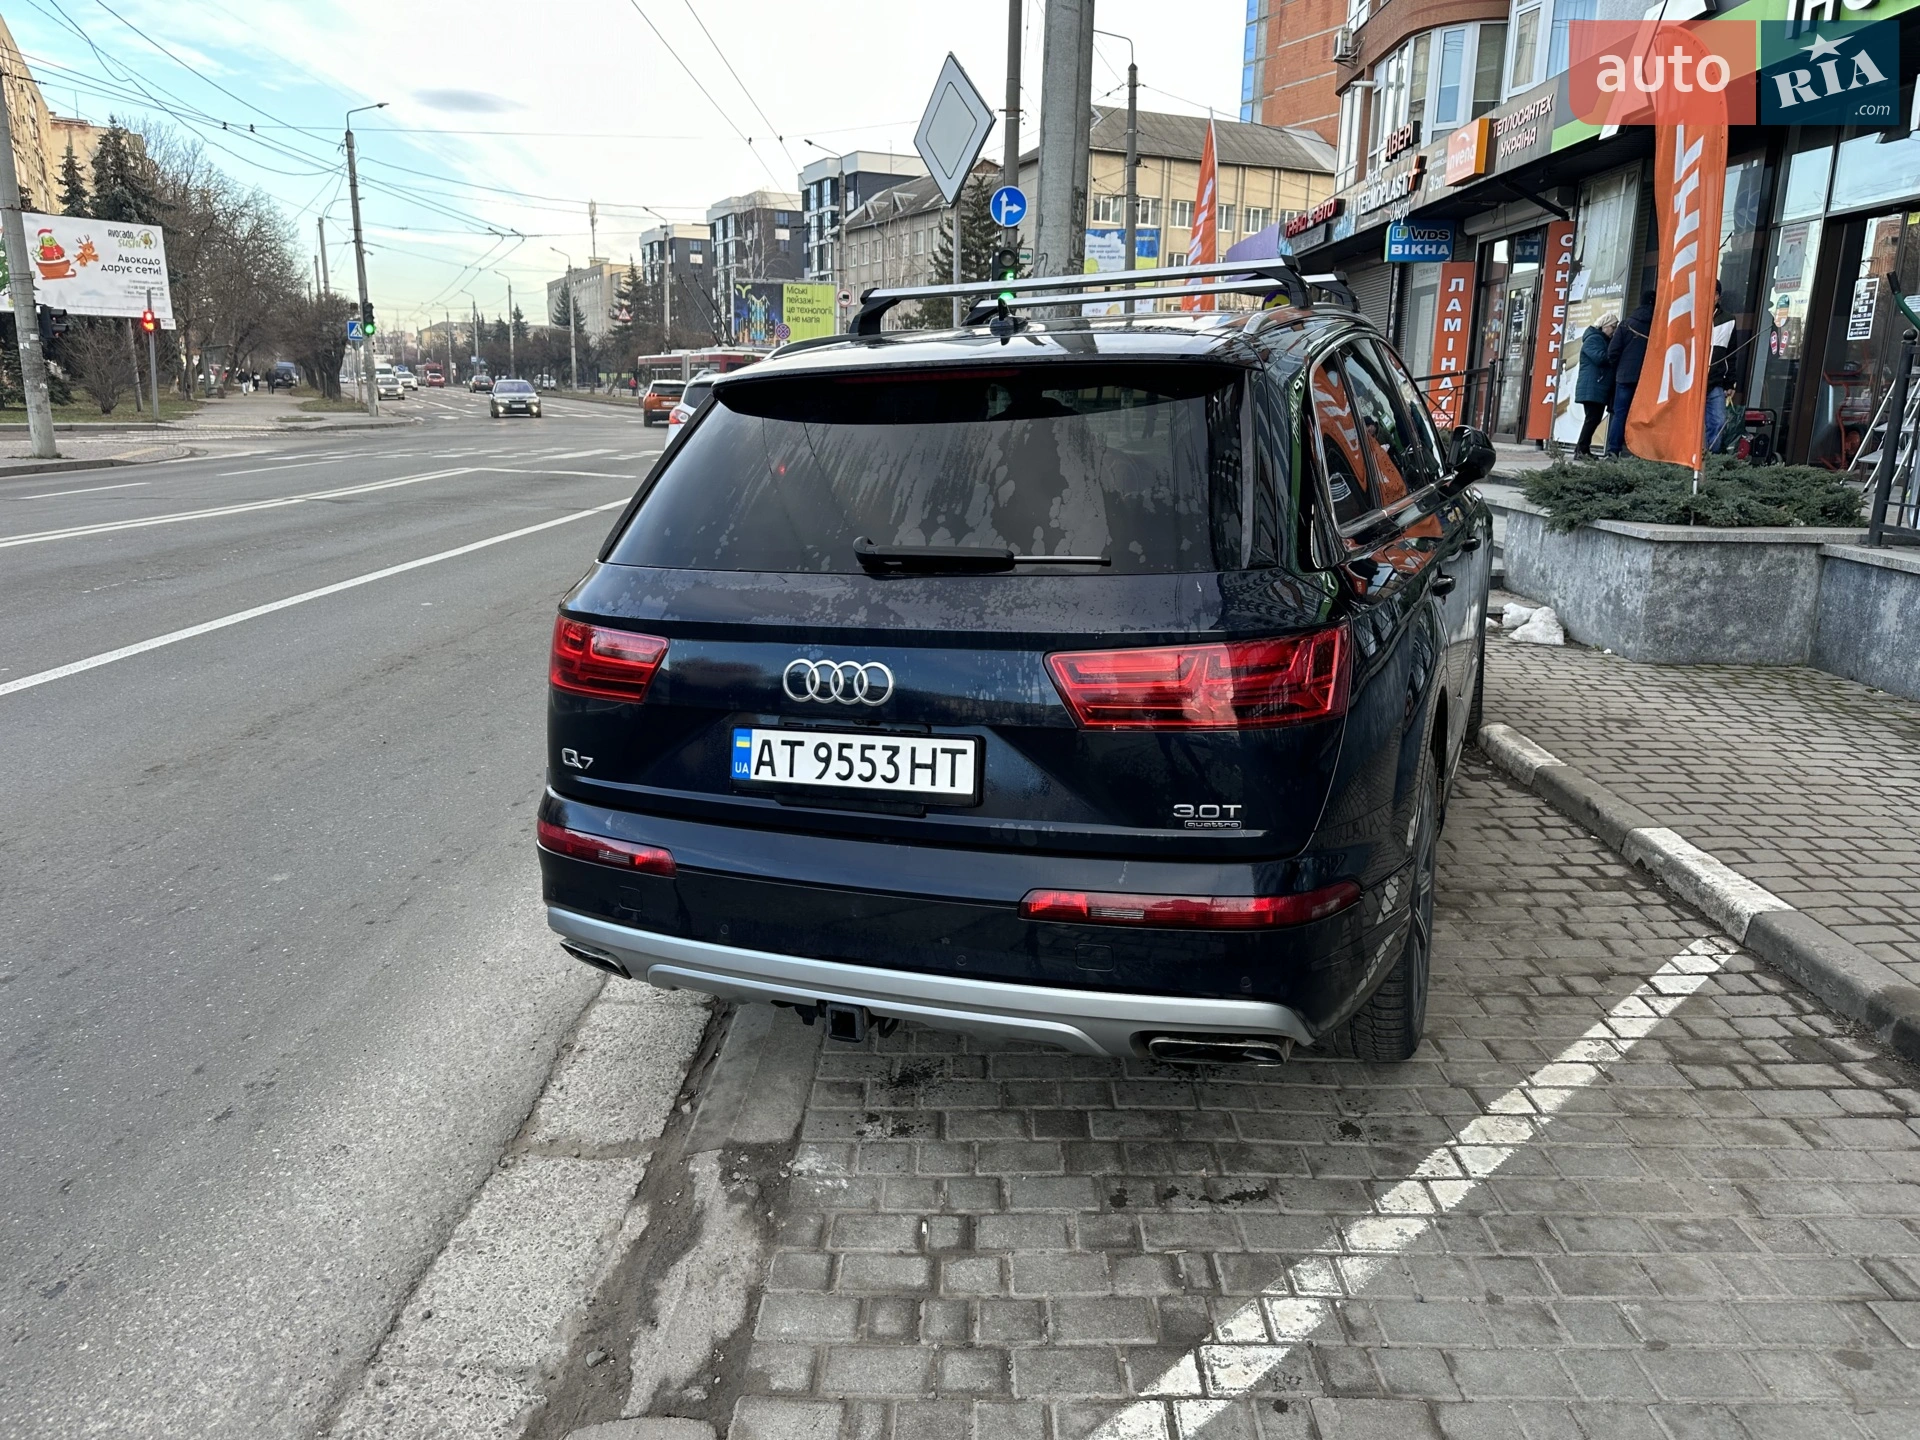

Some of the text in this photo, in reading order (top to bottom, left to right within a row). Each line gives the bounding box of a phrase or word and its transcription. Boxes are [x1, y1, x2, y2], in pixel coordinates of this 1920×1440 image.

[1493, 93, 1554, 139] ТЕПЛОСАНТЕХ
[1385, 120, 1414, 160] ДВЕРІ
[1501, 127, 1537, 159] УКРАЇНА
[1410, 226, 1450, 241] WDS
[1390, 244, 1450, 255] ВІКНА
[117, 254, 161, 266] Авокадо
[100, 264, 162, 275] дарує сети!
[786, 286, 808, 295] Міські
[786, 295, 814, 304] пейзажі
[786, 306, 795, 314] це
[1542, 233, 1573, 404] САНТЕХНІКА
[1438, 278, 1465, 409] ЛАМІНАТ
[561, 747, 594, 770] Q7
[753, 738, 968, 788] AT 9553 HT
[735, 761, 750, 775] UA
[1172, 803, 1242, 819] 3.0T
[1186, 821, 1240, 829] quattro
